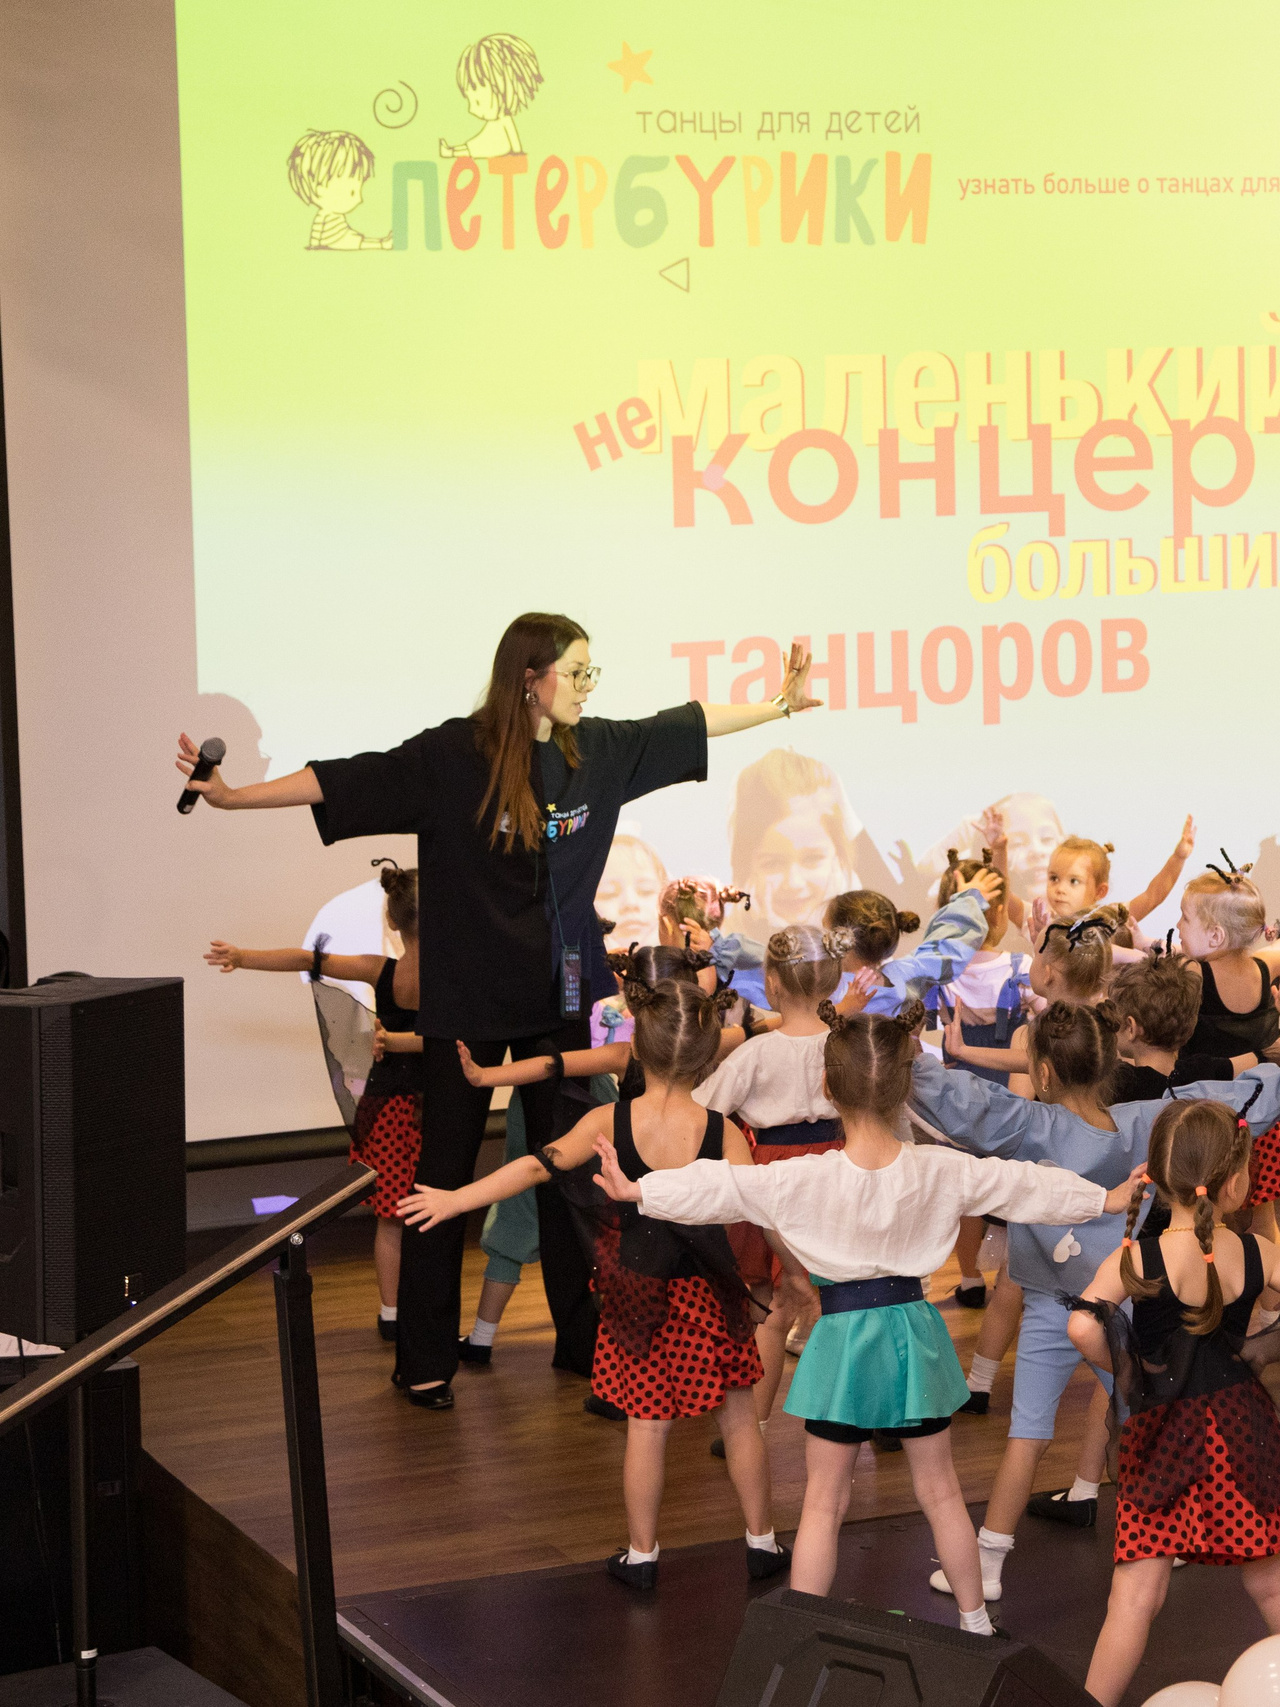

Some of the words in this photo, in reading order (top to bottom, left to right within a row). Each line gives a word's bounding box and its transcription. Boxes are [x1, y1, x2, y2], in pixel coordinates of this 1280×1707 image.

[635, 109, 742, 141] танцы
[757, 110, 811, 141] для
[825, 104, 921, 141] детей
[957, 175, 1035, 200] узнать
[1042, 172, 1130, 194] больше
[1137, 176, 1150, 194] о
[1156, 175, 1234, 197] танцах
[1240, 175, 1280, 197] для
[572, 396, 658, 472] не
[670, 616, 1151, 726] танцоров
